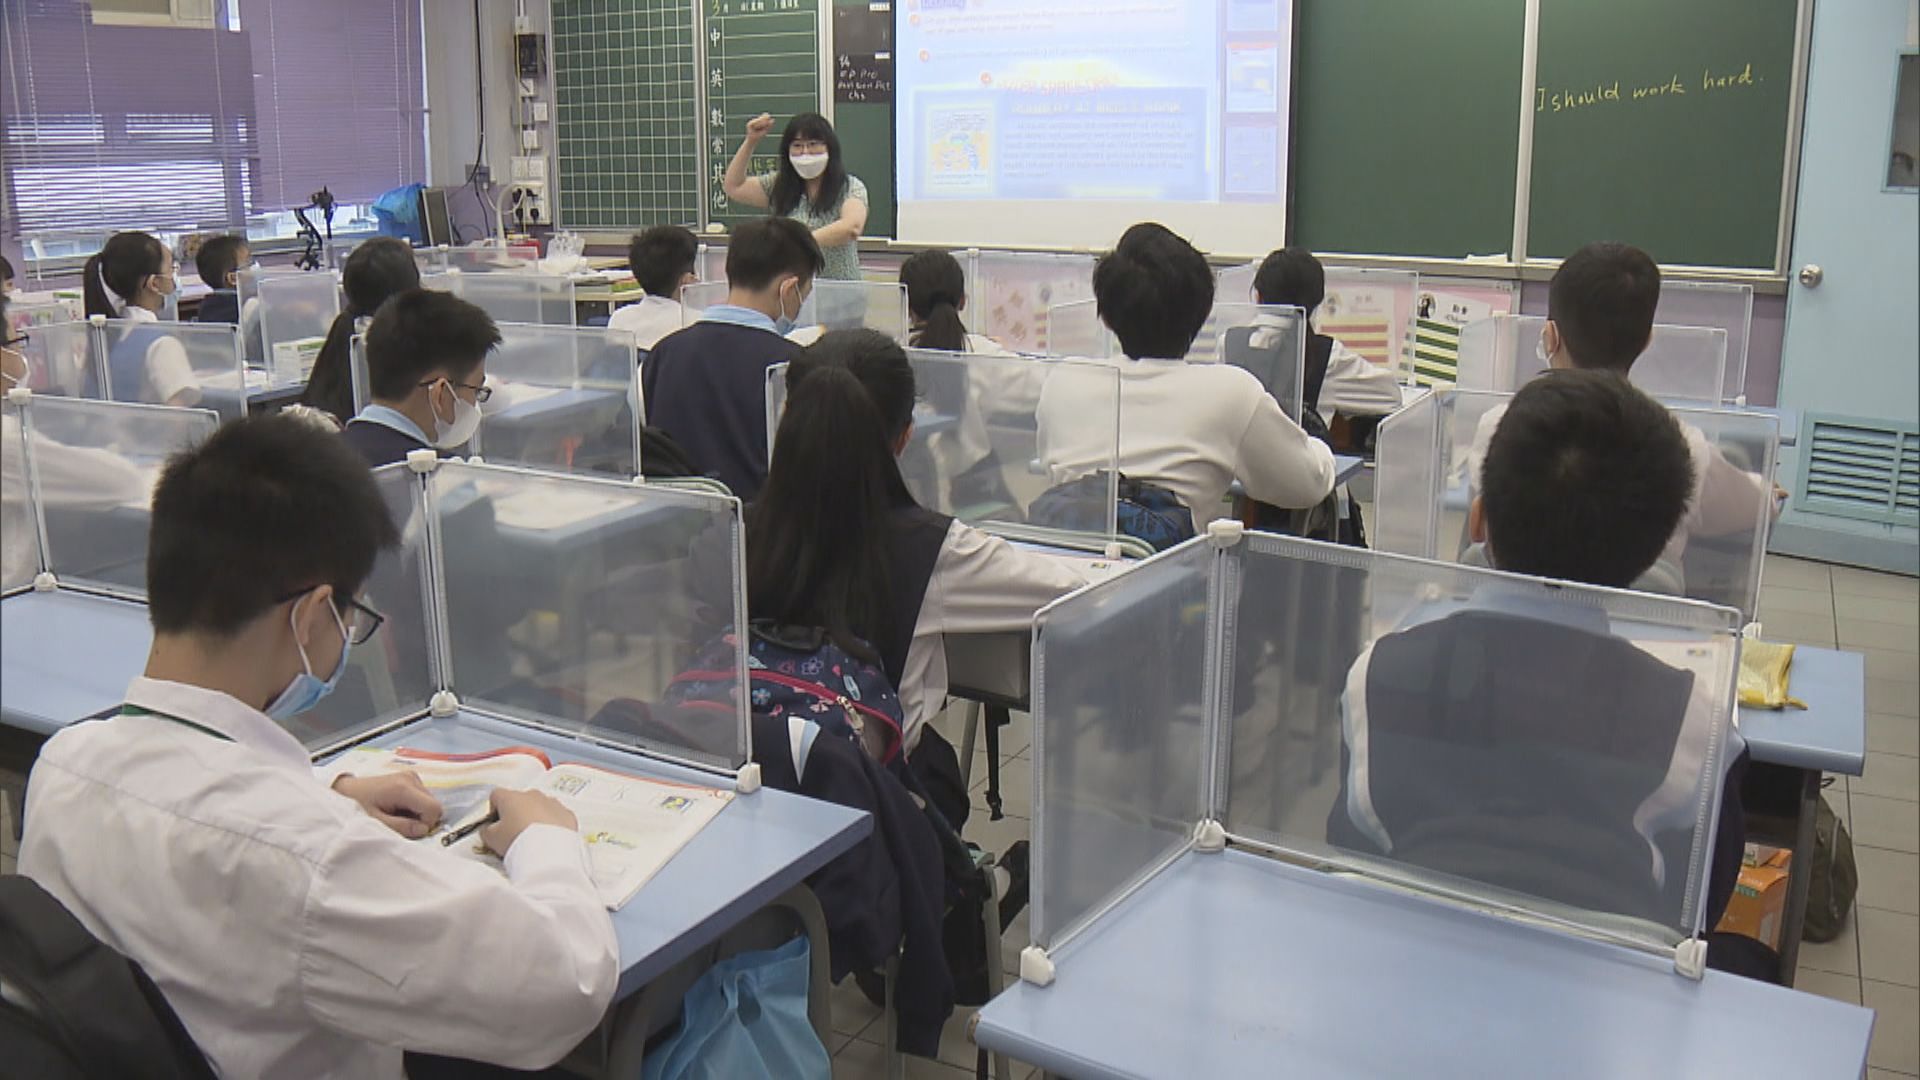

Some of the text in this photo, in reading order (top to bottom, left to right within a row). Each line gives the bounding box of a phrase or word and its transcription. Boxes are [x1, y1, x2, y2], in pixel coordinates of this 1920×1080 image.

[710, 28, 720, 47] 中
[710, 68, 723, 87] 英
[1537, 64, 1765, 112] I should work hard.
[710, 108, 724, 128] 數
